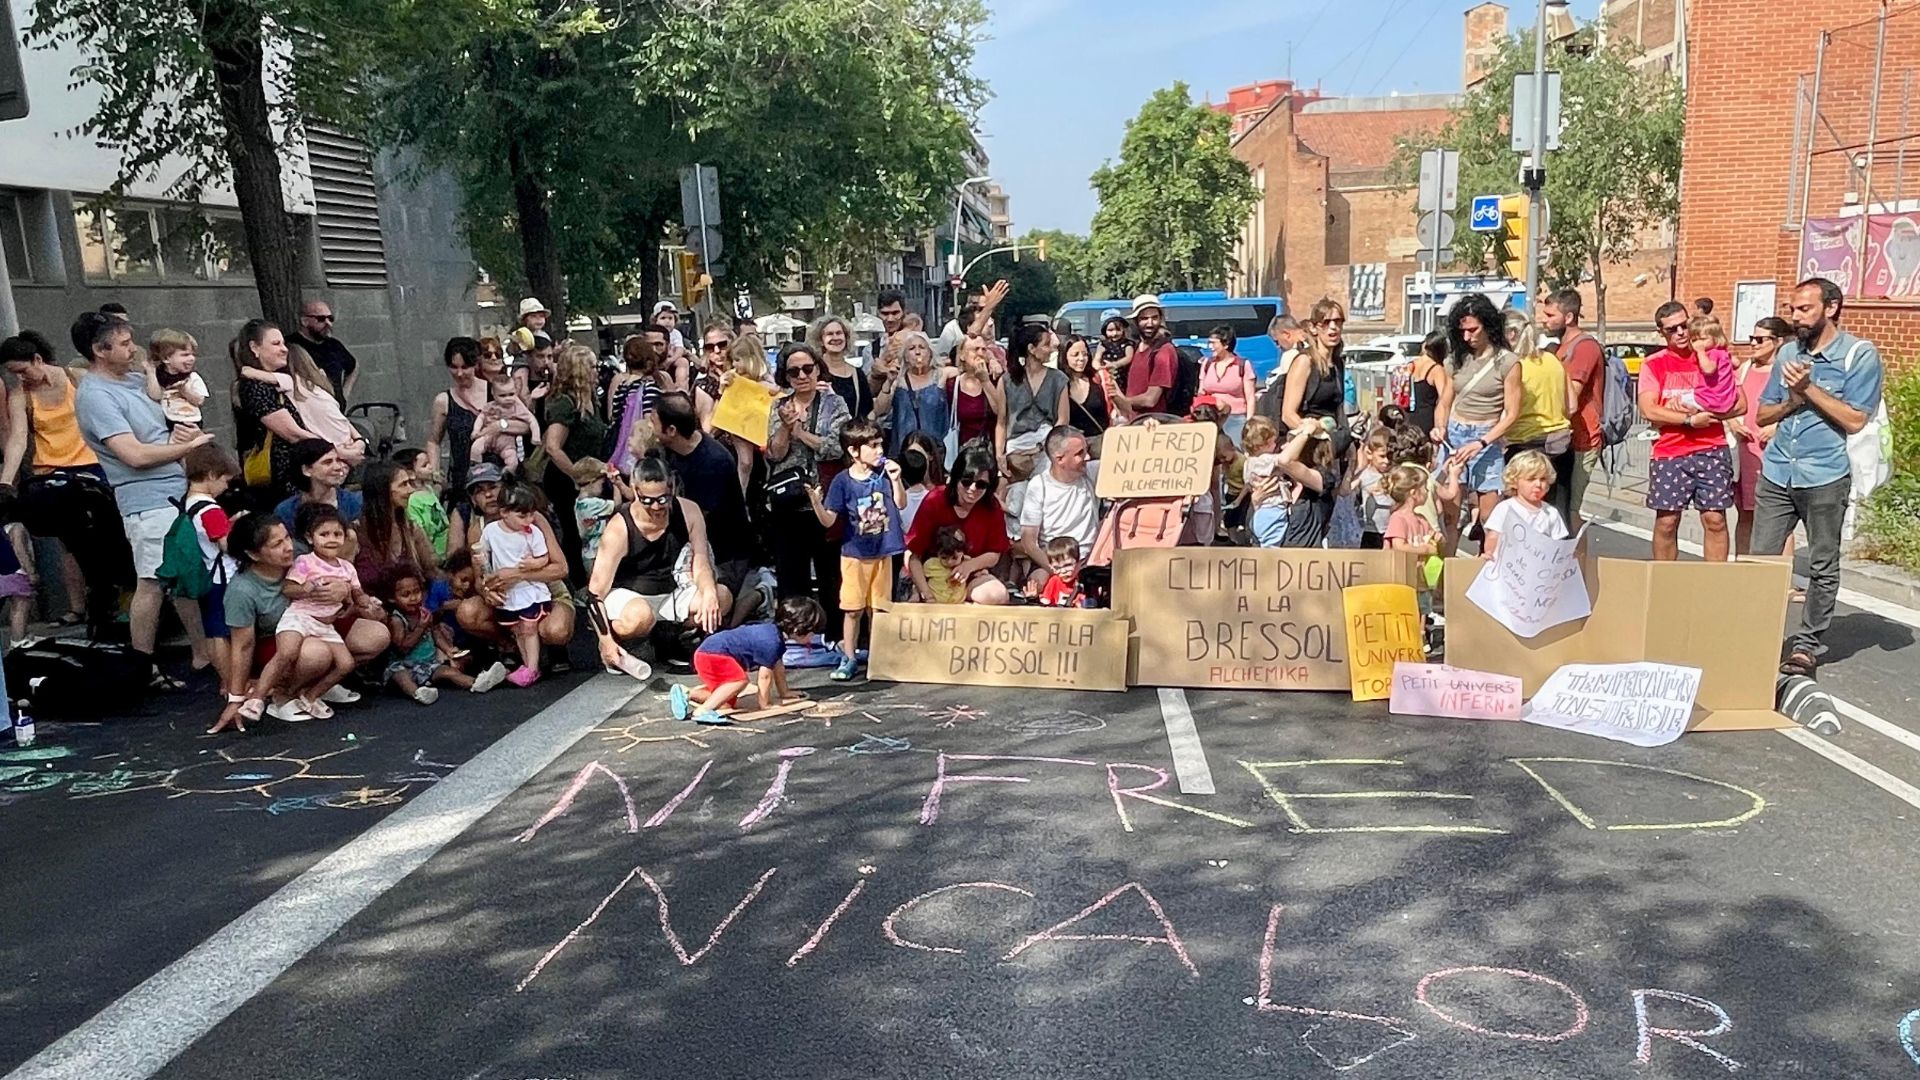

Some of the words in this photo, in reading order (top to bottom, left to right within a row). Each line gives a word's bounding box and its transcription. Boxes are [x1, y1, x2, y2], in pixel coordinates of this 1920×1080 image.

[1116, 433, 1140, 453] NI
[1151, 432, 1205, 453] FRED
[1113, 460, 1136, 474] NI
[1142, 457, 1199, 475] CALOR
[1121, 477, 1193, 493] ALCHEMIKA
[1168, 557, 1257, 591] CLIMA
[1277, 559, 1366, 591] DIGNE
[1237, 596, 1249, 612] A
[1267, 596, 1291, 612] LA
[899, 617, 957, 643] CLIMA
[977, 621, 1039, 644] DIGNE
[1048, 623, 1060, 644] A
[1067, 624, 1094, 647] LA
[1186, 619, 1343, 663] BRESSOL
[1209, 666, 1309, 683] ALCHEMIKA
[1450, 679, 1515, 694] UNIVERS
[511, 745, 818, 843] NI
[918, 748, 1768, 836] FRED
[882, 880, 1748, 1074] CALOR
